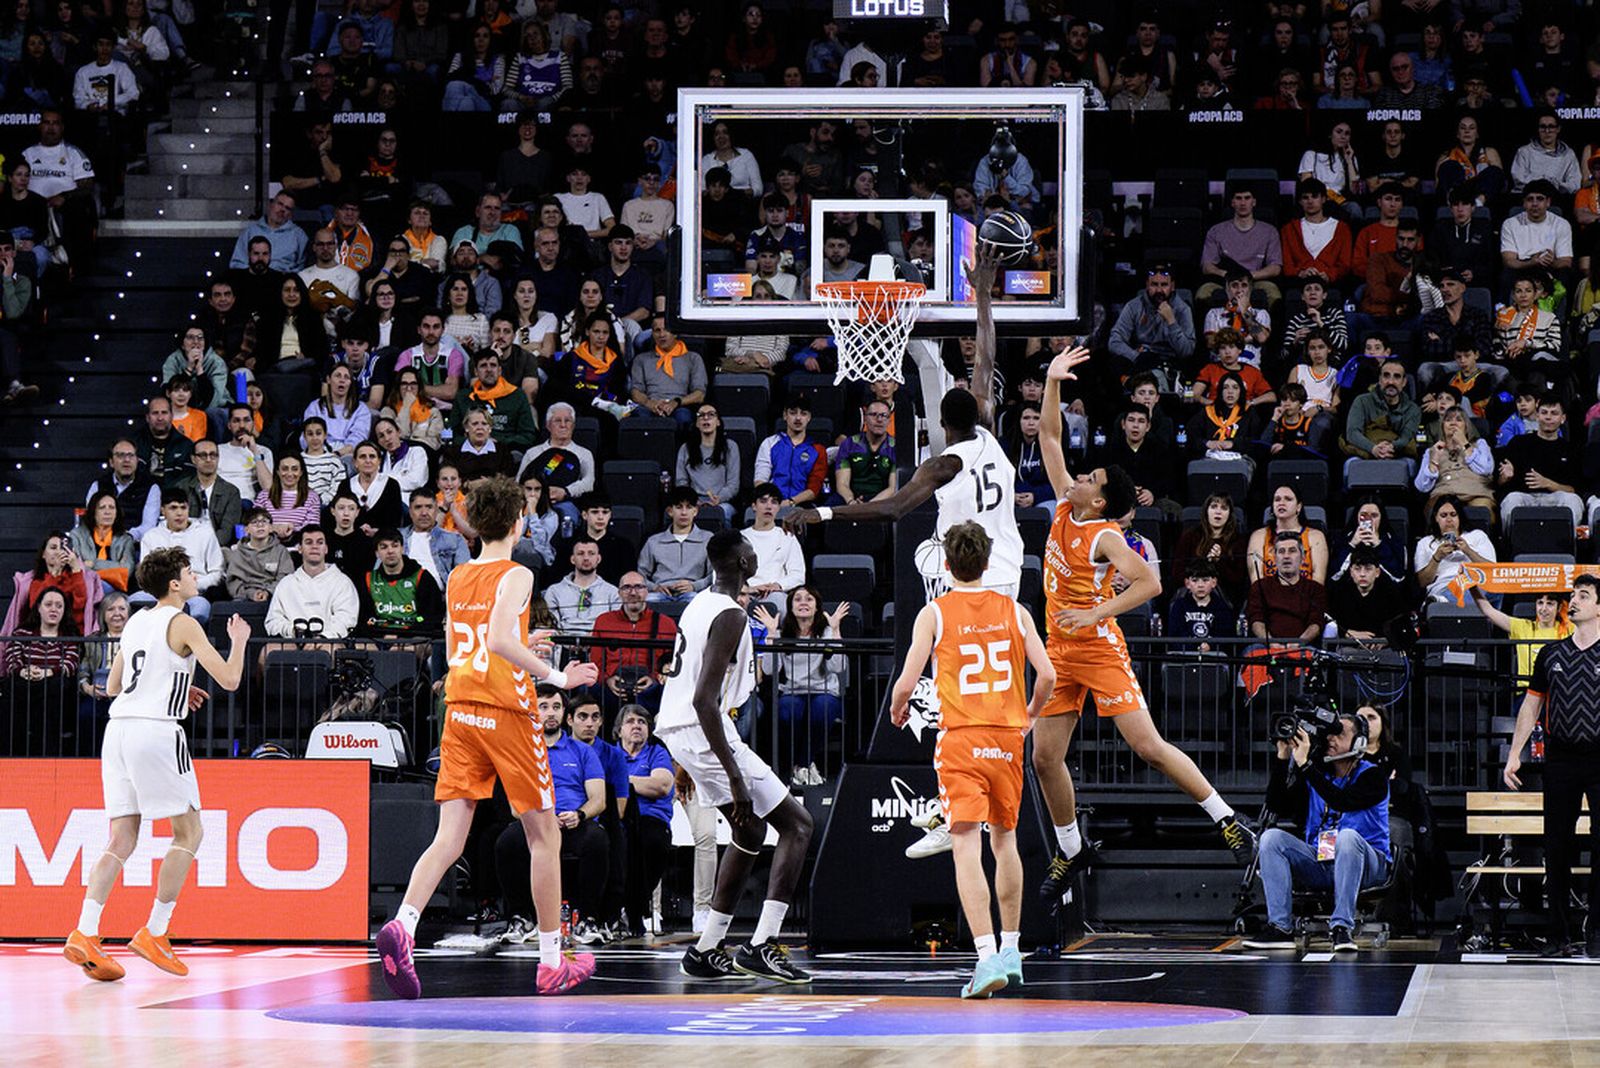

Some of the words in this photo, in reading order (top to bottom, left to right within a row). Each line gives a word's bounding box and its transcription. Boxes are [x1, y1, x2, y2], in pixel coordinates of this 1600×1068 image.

[851, 0, 924, 16] LOTUS
[333, 111, 366, 124] #COPA
[366, 111, 387, 124] ACB
[1188, 110, 1223, 122] #COPA
[1223, 110, 1244, 122] ACB
[1401, 109, 1422, 121] ACB
[969, 462, 1003, 513] 15
[1492, 566, 1560, 577] CAMPIONS
[377, 600, 417, 614] Cajasol
[959, 639, 1013, 695] 25
[451, 711, 496, 730] PAMESA
[323, 734, 379, 749] Wilson
[871, 822, 891, 833] acb
